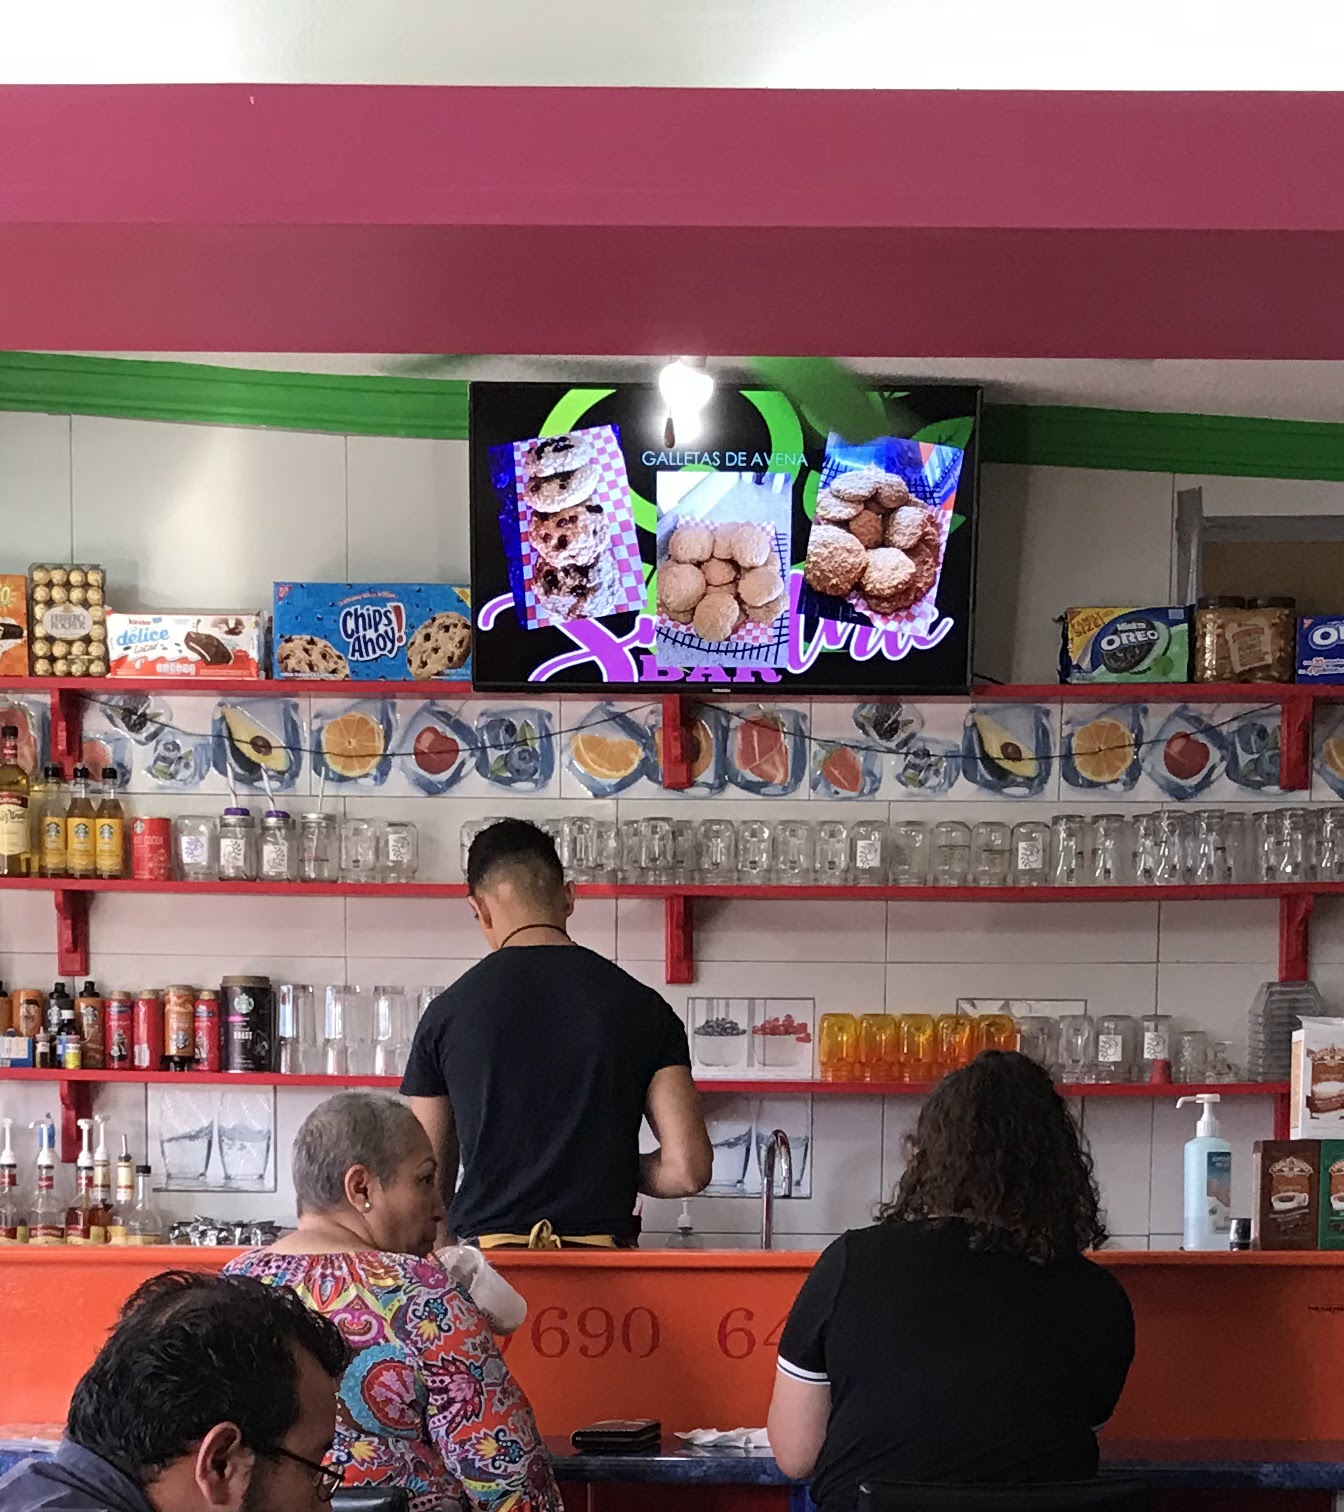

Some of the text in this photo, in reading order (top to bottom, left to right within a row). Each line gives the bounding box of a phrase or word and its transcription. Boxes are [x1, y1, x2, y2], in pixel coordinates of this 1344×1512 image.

[641, 450, 809, 467] GALLETAS DE AVENA
[341, 607, 394, 640] Chips
[1100, 630, 1160, 652] OREO
[531, 1306, 661, 1359] 690
